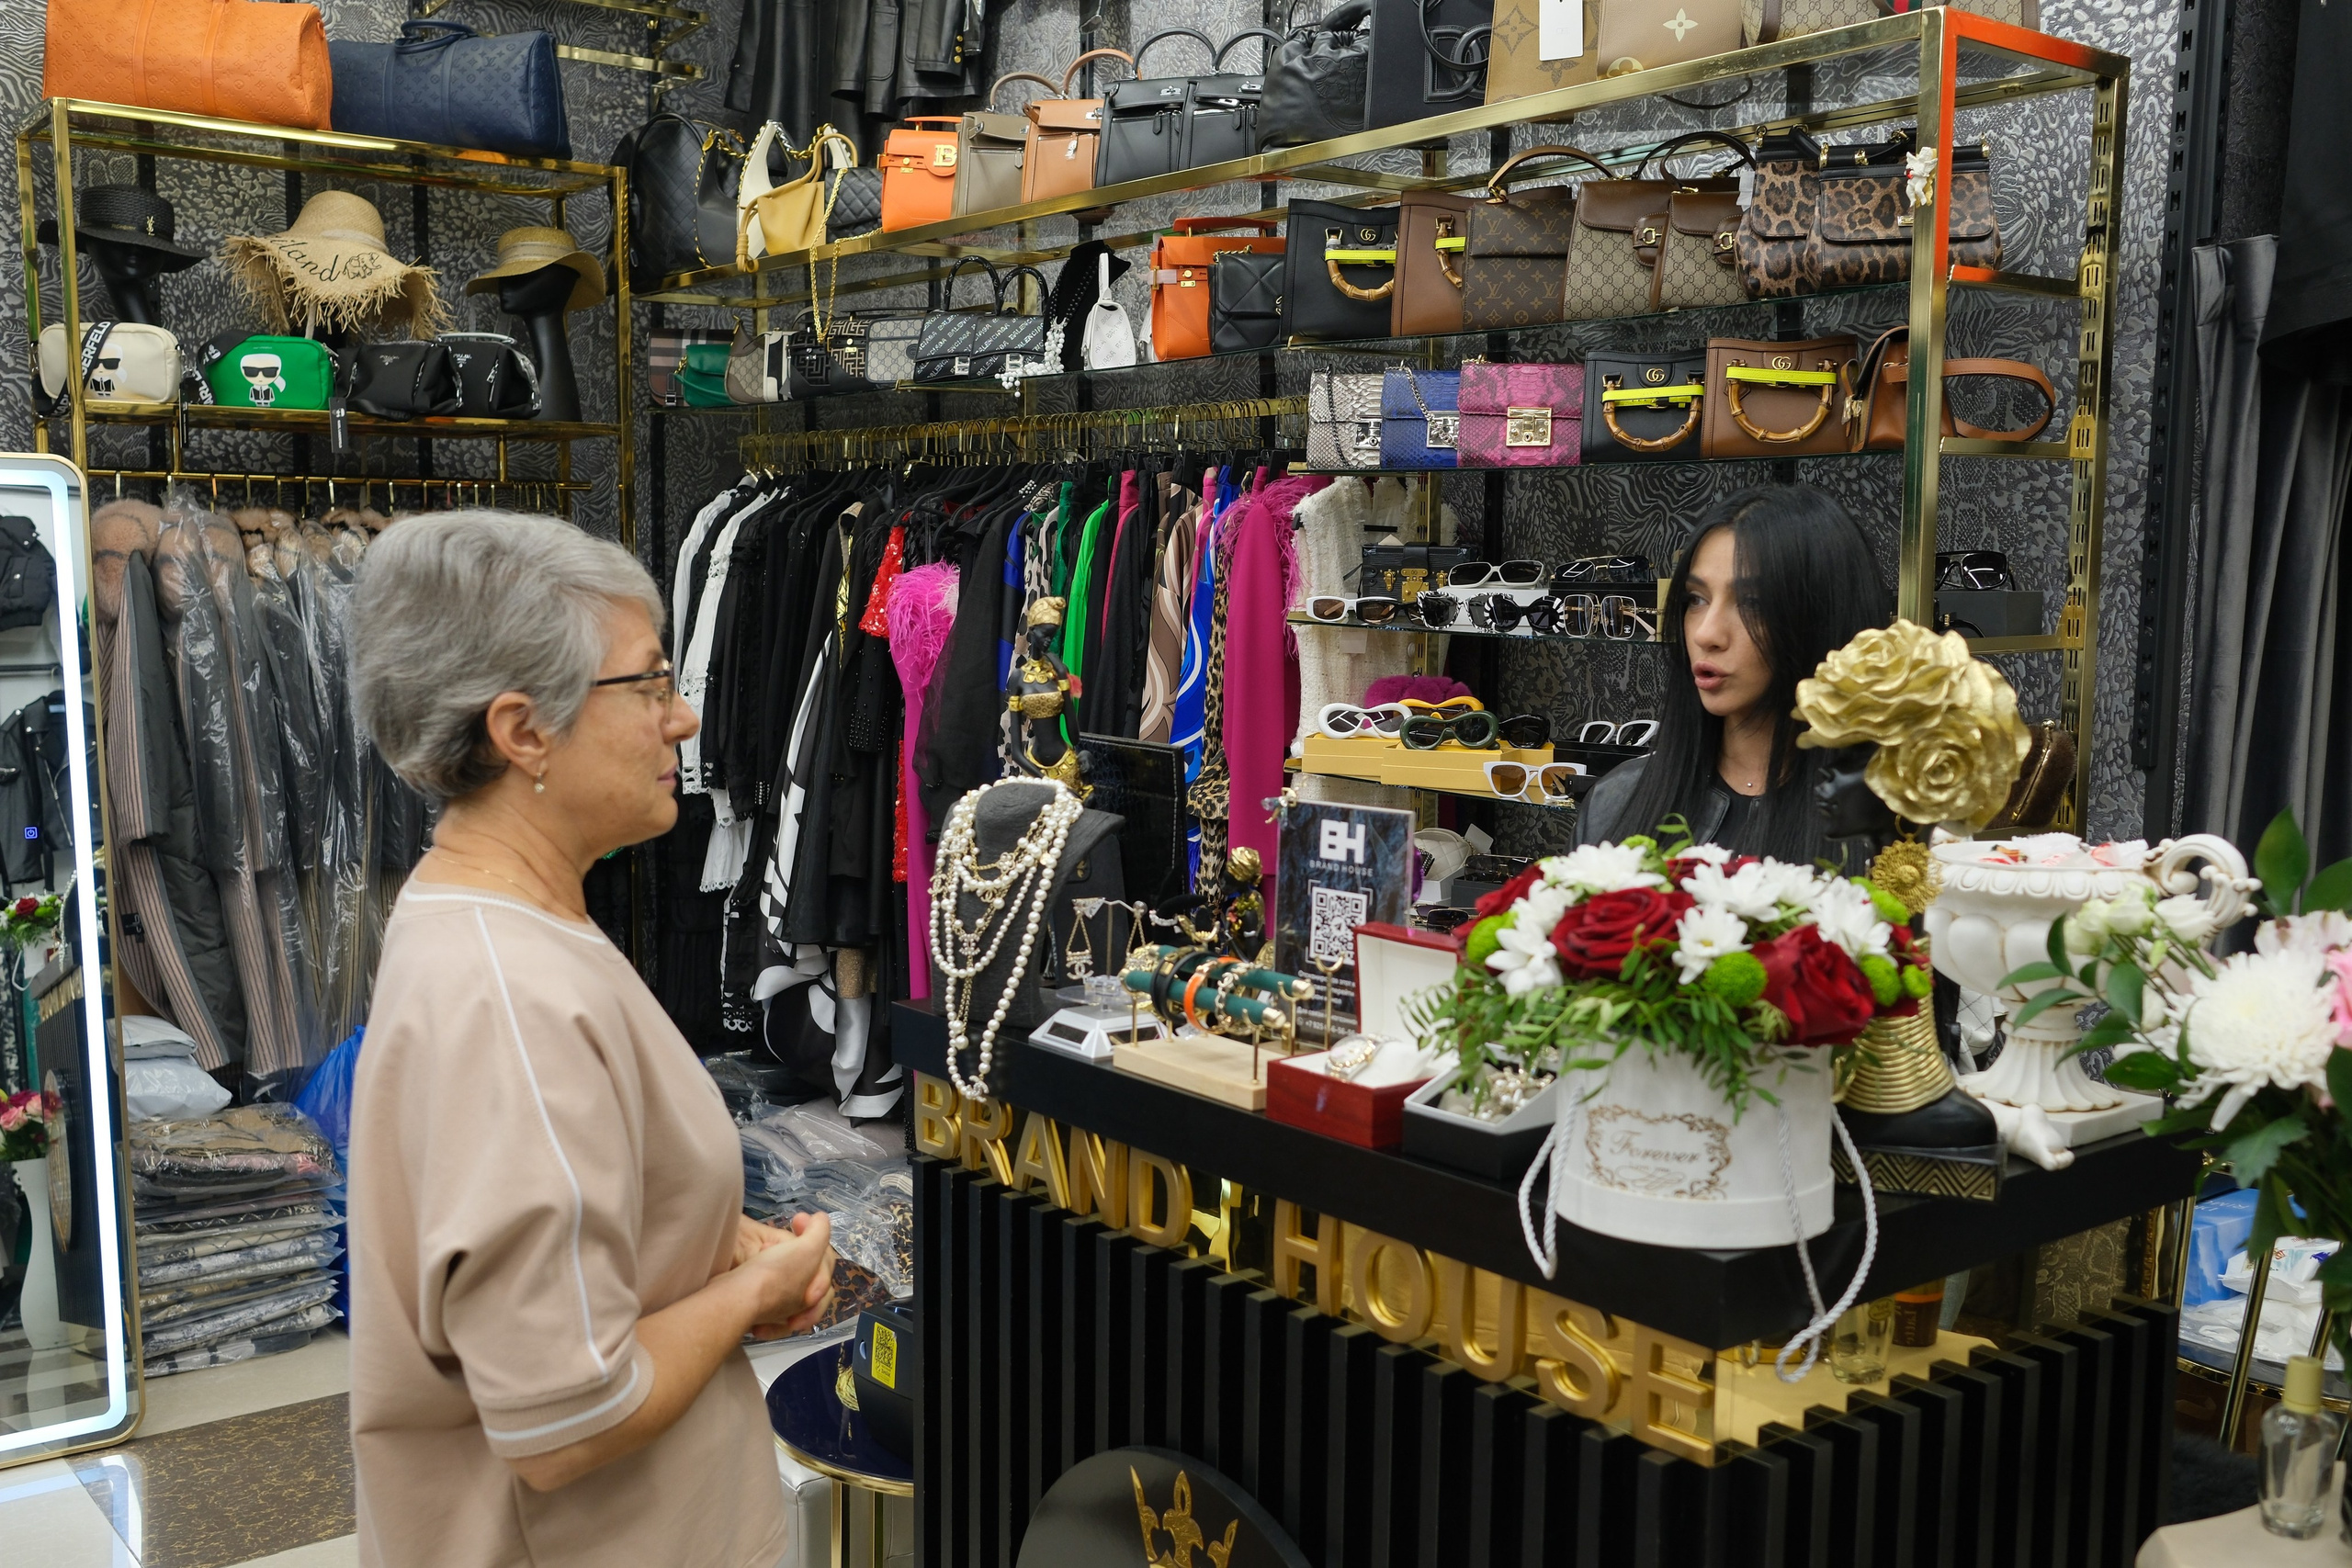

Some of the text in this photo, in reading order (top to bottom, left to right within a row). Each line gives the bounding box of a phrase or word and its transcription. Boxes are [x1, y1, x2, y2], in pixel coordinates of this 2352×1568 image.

[1308, 859, 1374, 878] BRAND HOUSE
[1610, 1130, 1700, 1163] Forever
[914, 1071, 1714, 1468] BRAND HOUSE
